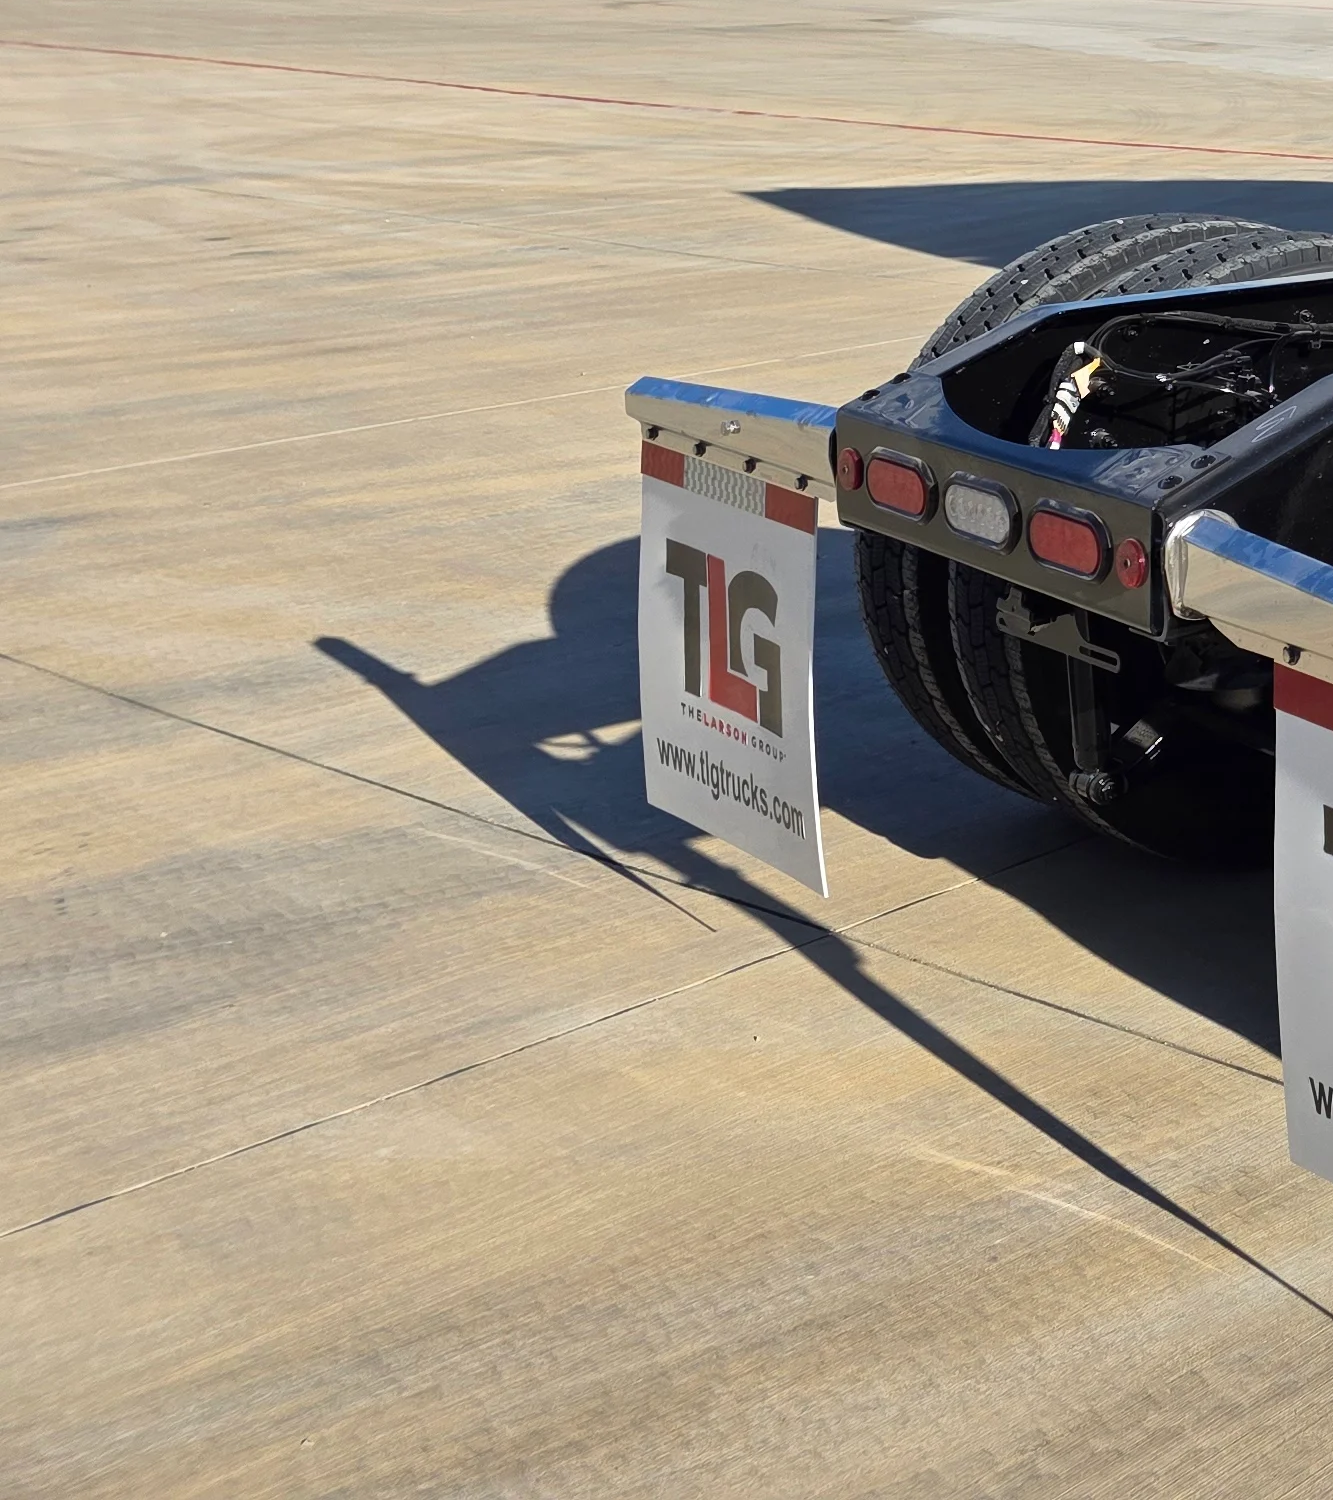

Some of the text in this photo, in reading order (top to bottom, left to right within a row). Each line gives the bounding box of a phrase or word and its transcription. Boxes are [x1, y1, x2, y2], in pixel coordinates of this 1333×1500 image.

[666, 538, 783, 739] TLG
[657, 737, 806, 841] www.tlgtrucks.com
[752, 735, 785, 763] GROUP
